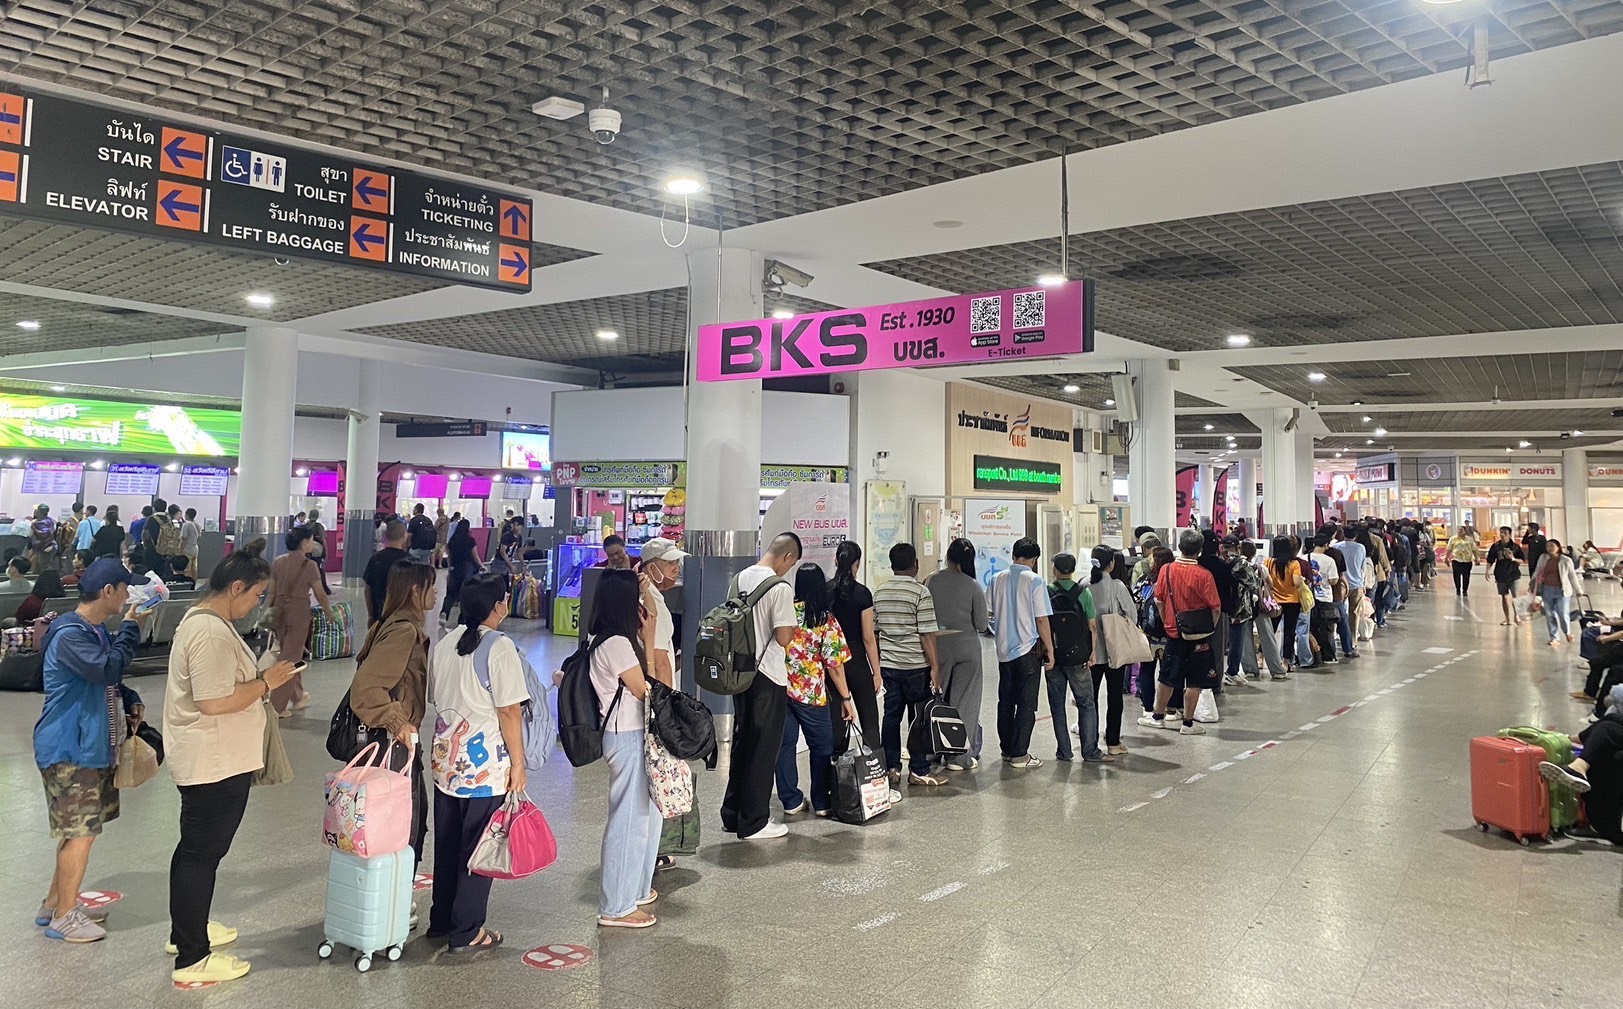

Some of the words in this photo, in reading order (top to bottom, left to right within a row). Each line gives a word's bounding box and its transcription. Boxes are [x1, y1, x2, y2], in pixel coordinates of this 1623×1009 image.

[106, 119, 155, 145] บันได
[97, 147, 153, 169] STAIR
[320, 166, 348, 185] สุขา
[106, 177, 149, 201] ลิฟท์
[294, 183, 347, 204] TOILET
[45, 191, 149, 221] ELEVATOR
[424, 187, 494, 216] จำหน่ายตั๋ว
[268, 202, 345, 231] รับฝากของ
[421, 208, 494, 233] TICKETING
[222, 223, 263, 242] LEFT
[266, 230, 344, 255] BAGGAGE
[405, 228, 491, 255] ประชาสัมพันธ์
[399, 251, 490, 277] INFORMATION
[720, 312, 868, 375] BKS
[893, 336, 945, 362] บขส.
[988, 346, 1026, 357] E-Ticket
[957, 410, 1008, 433] ประชาสัมพันธ์
[27, 462, 36, 470] 30
[556, 467, 576, 479] PNP
[1519, 467, 1556, 475] DONUTS
[792, 519, 813, 529] NEW
[814, 519, 830, 528] BUS
[823, 536, 839, 547] EURO
